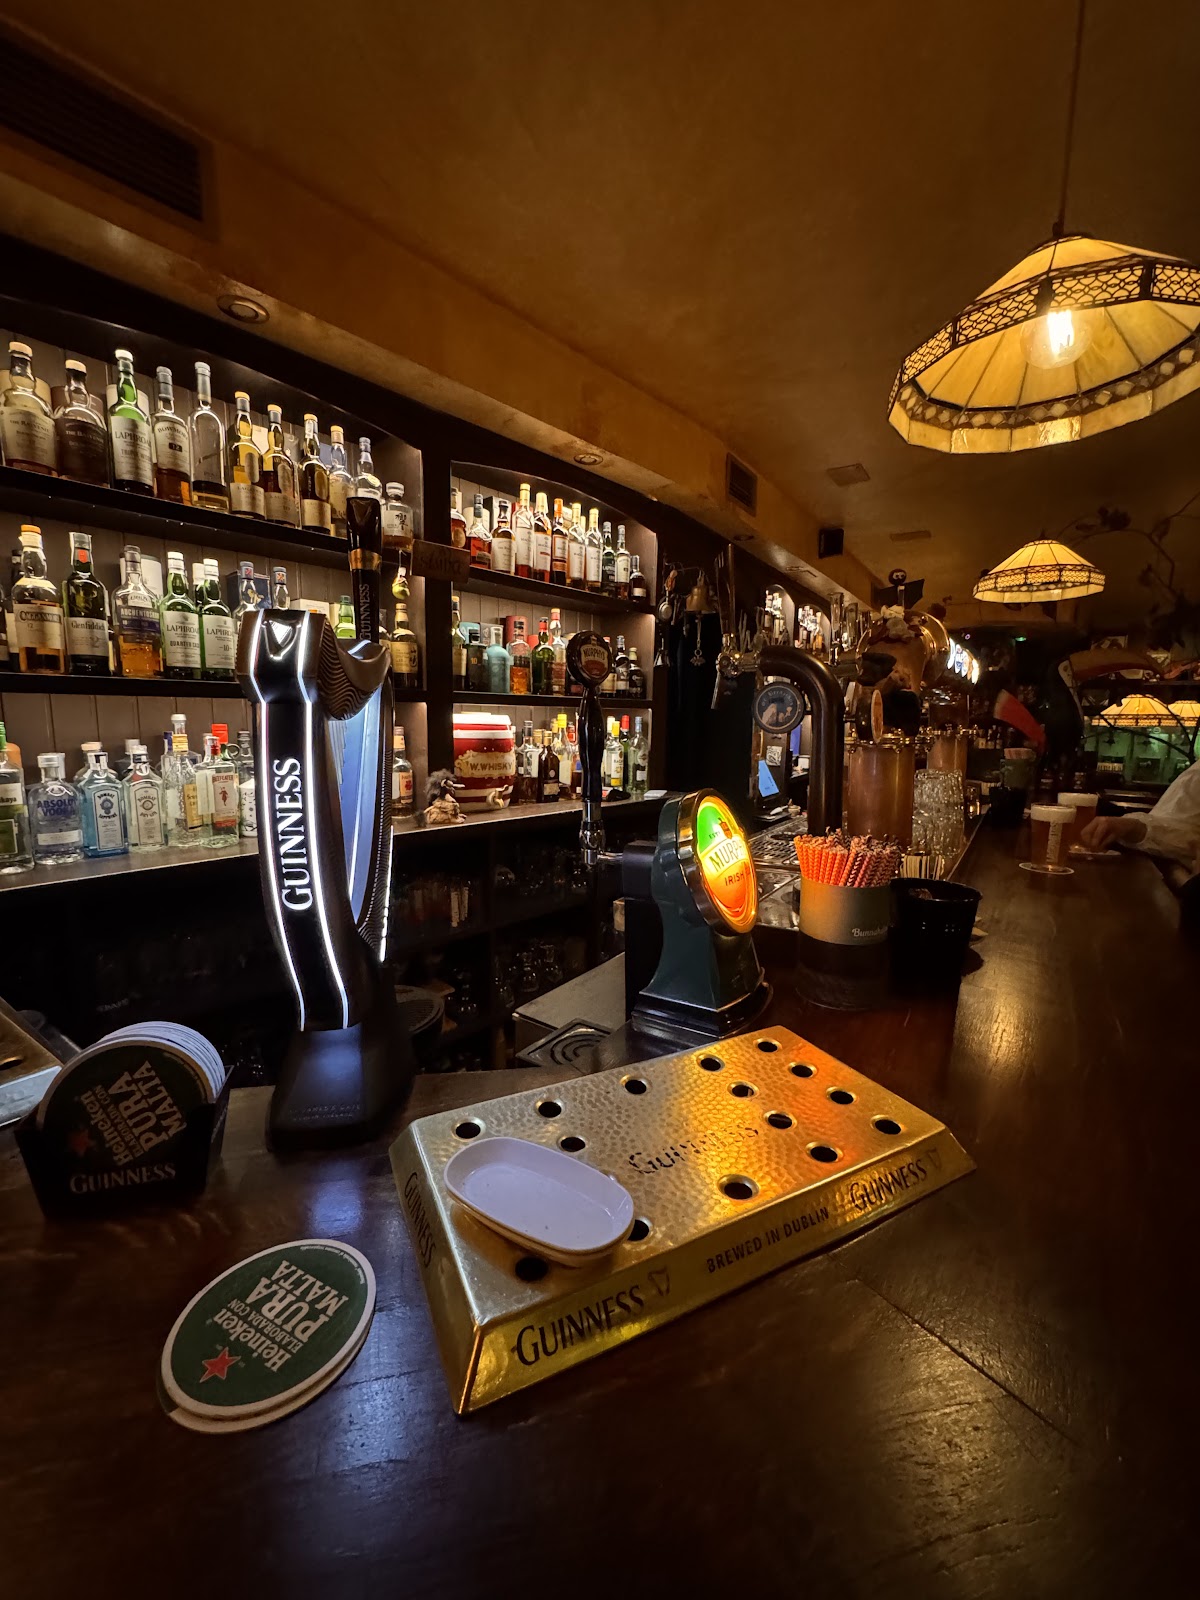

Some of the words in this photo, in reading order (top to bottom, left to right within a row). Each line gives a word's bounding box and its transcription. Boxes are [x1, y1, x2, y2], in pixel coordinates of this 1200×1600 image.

[358, 583, 372, 641] GUINNESS
[273, 757, 314, 912] GUINNESS
[93, 1084, 112, 1105] CON
[107, 1071, 170, 1152] PURA
[132, 1060, 188, 1139] MALTA
[80, 1090, 135, 1167] Heineken
[107, 1103, 145, 1159] ELABORADA
[69, 1163, 177, 1195] GUINNESS
[848, 1158, 928, 1211] GUINNESS
[404, 1171, 437, 1268] GUINNESS
[706, 1236, 763, 1273] BREWED
[765, 1228, 781, 1246] IN
[782, 1206, 829, 1239] DUBLIN
[226, 1298, 251, 1317] CON
[244, 1276, 331, 1343] PURA
[270, 1259, 350, 1318] MALTA
[212, 1308, 293, 1373] Heineken
[247, 1311, 304, 1354] ELABORADA
[513, 1284, 645, 1366] GUINNESS
